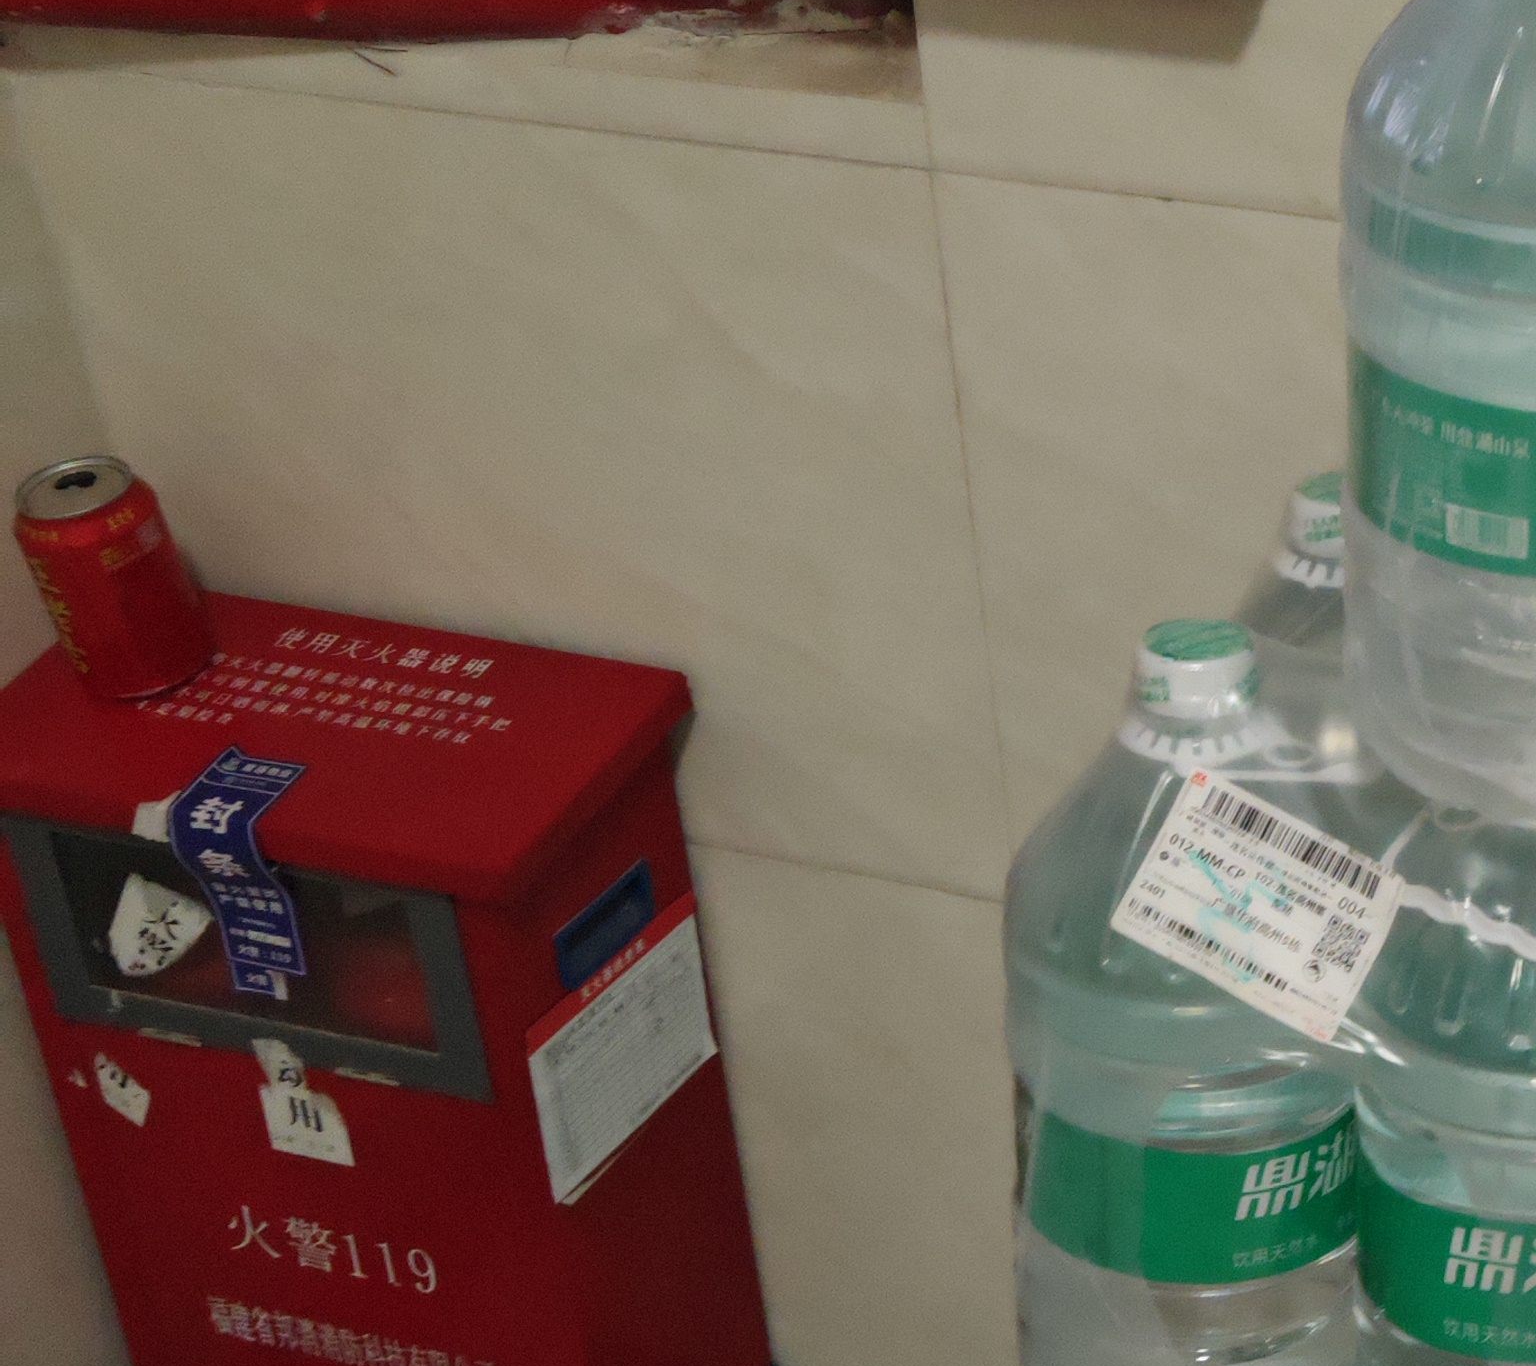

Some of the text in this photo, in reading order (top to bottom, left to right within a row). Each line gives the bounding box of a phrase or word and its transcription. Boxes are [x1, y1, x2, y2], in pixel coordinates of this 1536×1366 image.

[274, 627, 495, 680] 使用灭火器说明
[228, 1204, 438, 1295] 火警119
